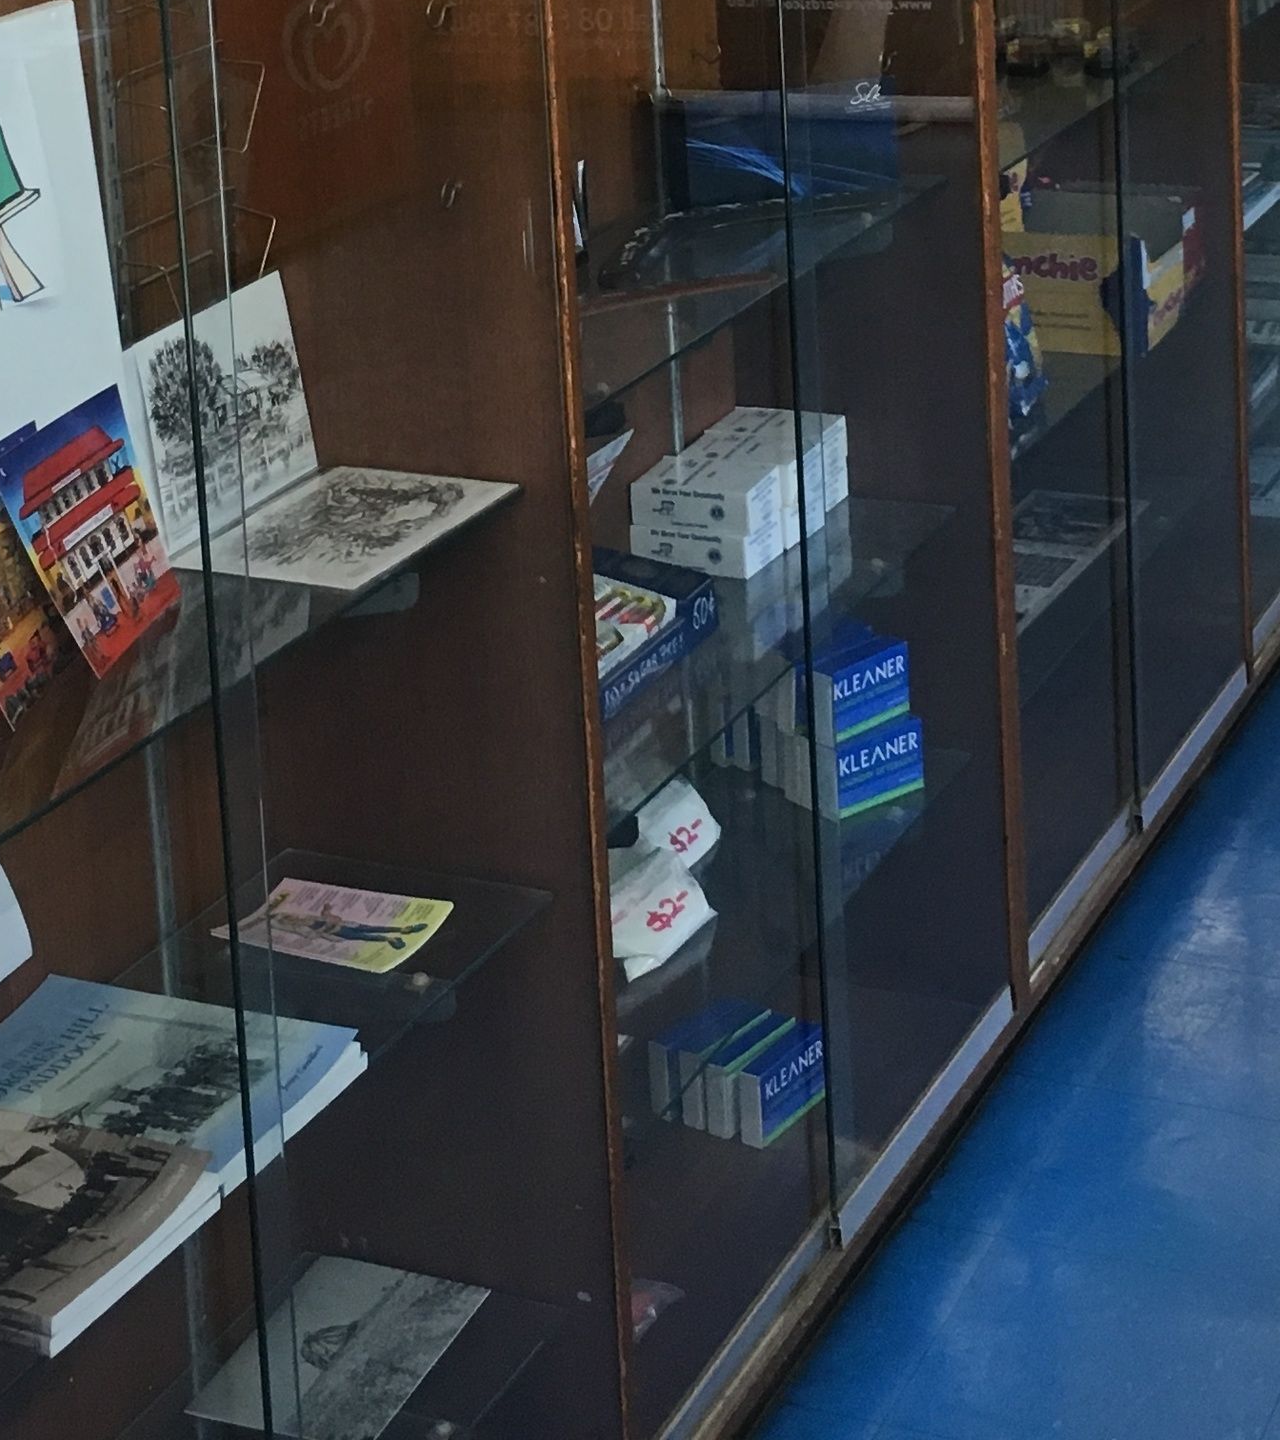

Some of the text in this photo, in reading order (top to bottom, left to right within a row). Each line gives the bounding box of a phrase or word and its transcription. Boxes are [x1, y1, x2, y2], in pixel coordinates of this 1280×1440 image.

[833, 654, 905, 702] KLEANER
[838, 731, 919, 778] KLEANER
[18, 1031, 107, 1094] PADDOCK
[765, 1040, 823, 1101] KLEANER
